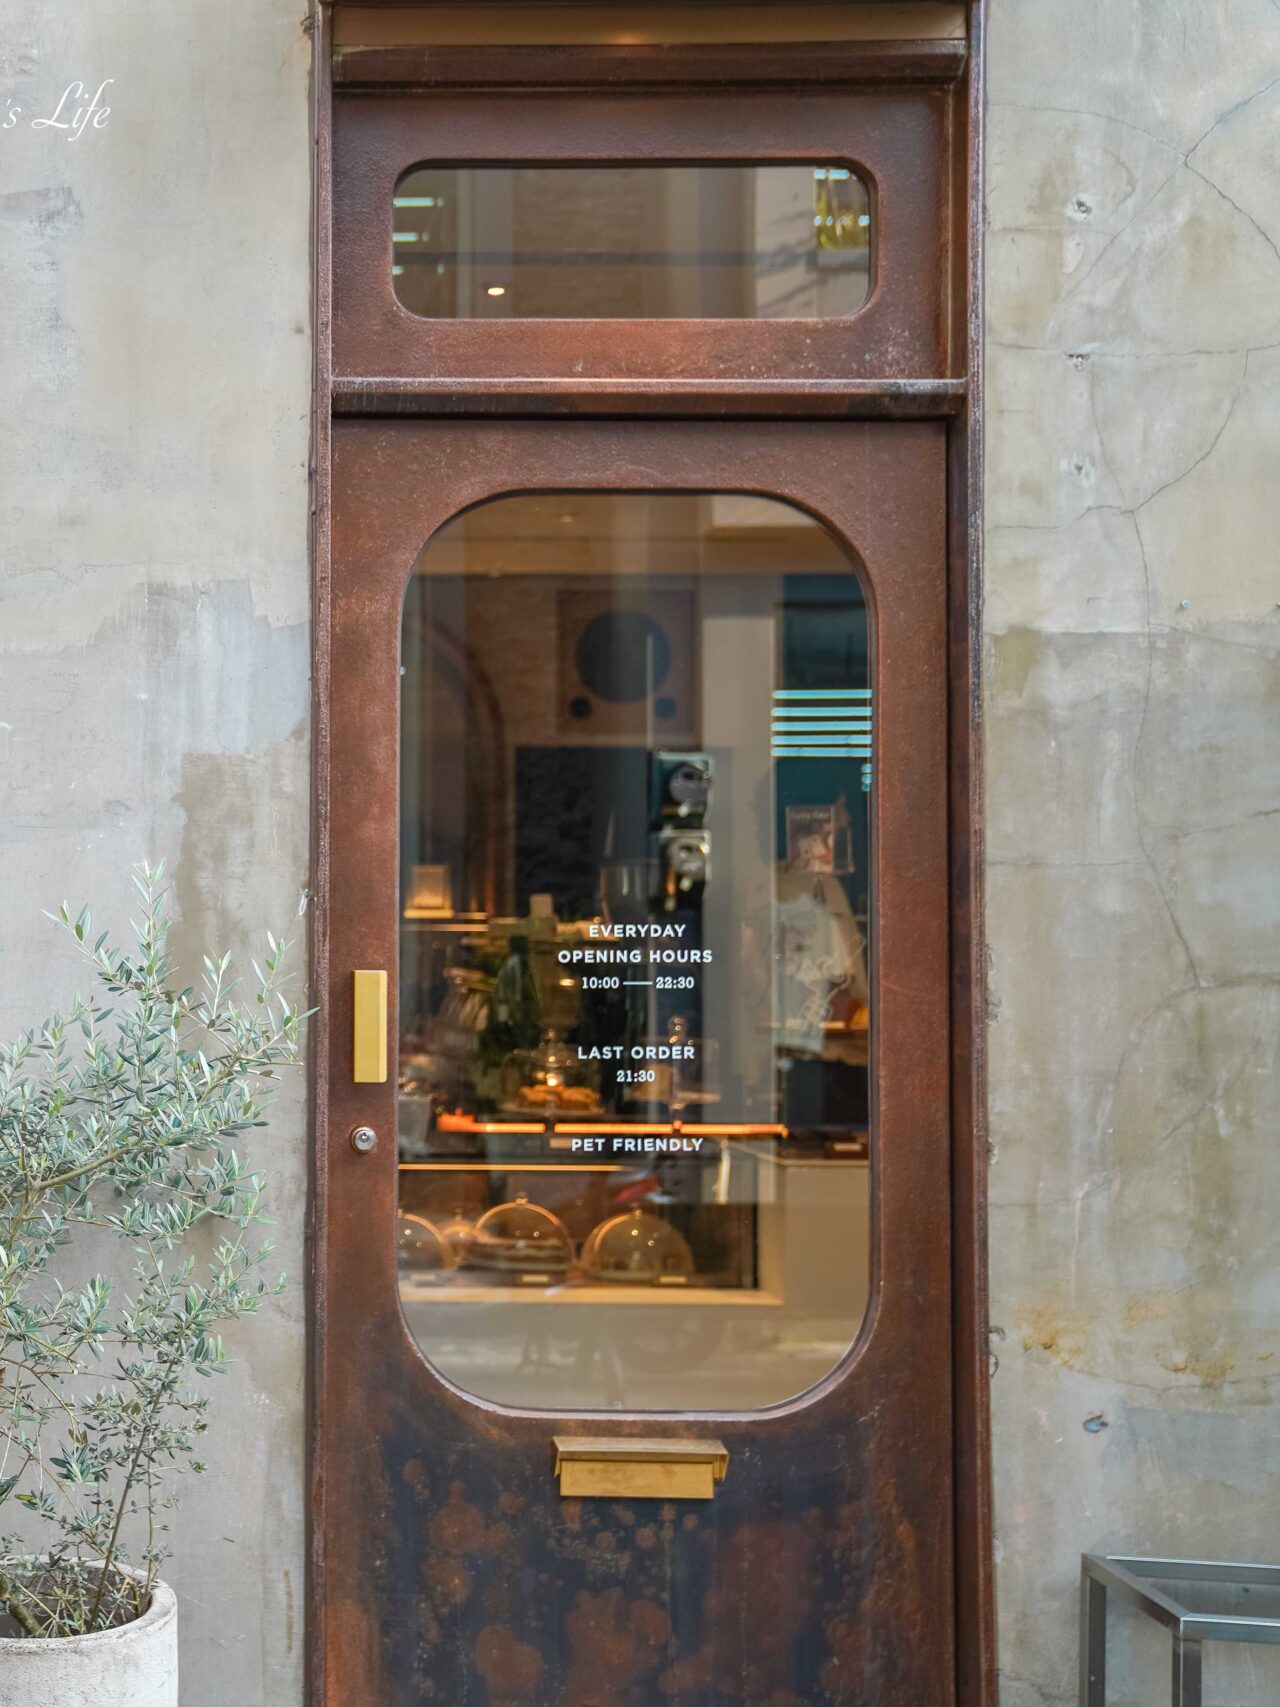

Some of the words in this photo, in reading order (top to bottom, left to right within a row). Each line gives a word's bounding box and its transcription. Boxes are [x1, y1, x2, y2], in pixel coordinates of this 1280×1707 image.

[588, 924, 687, 938] EVERYDAY
[557, 949, 642, 964] OPENING
[649, 949, 714, 964] HOURS
[581, 976, 620, 989] 10:00
[655, 976, 695, 989] 22:30
[577, 1046, 625, 1060] LAST
[631, 1046, 696, 1060] ORDER
[616, 1069, 656, 1083] 21:30
[571, 1137, 606, 1152] PET
[612, 1137, 704, 1152] FRIENDLY
